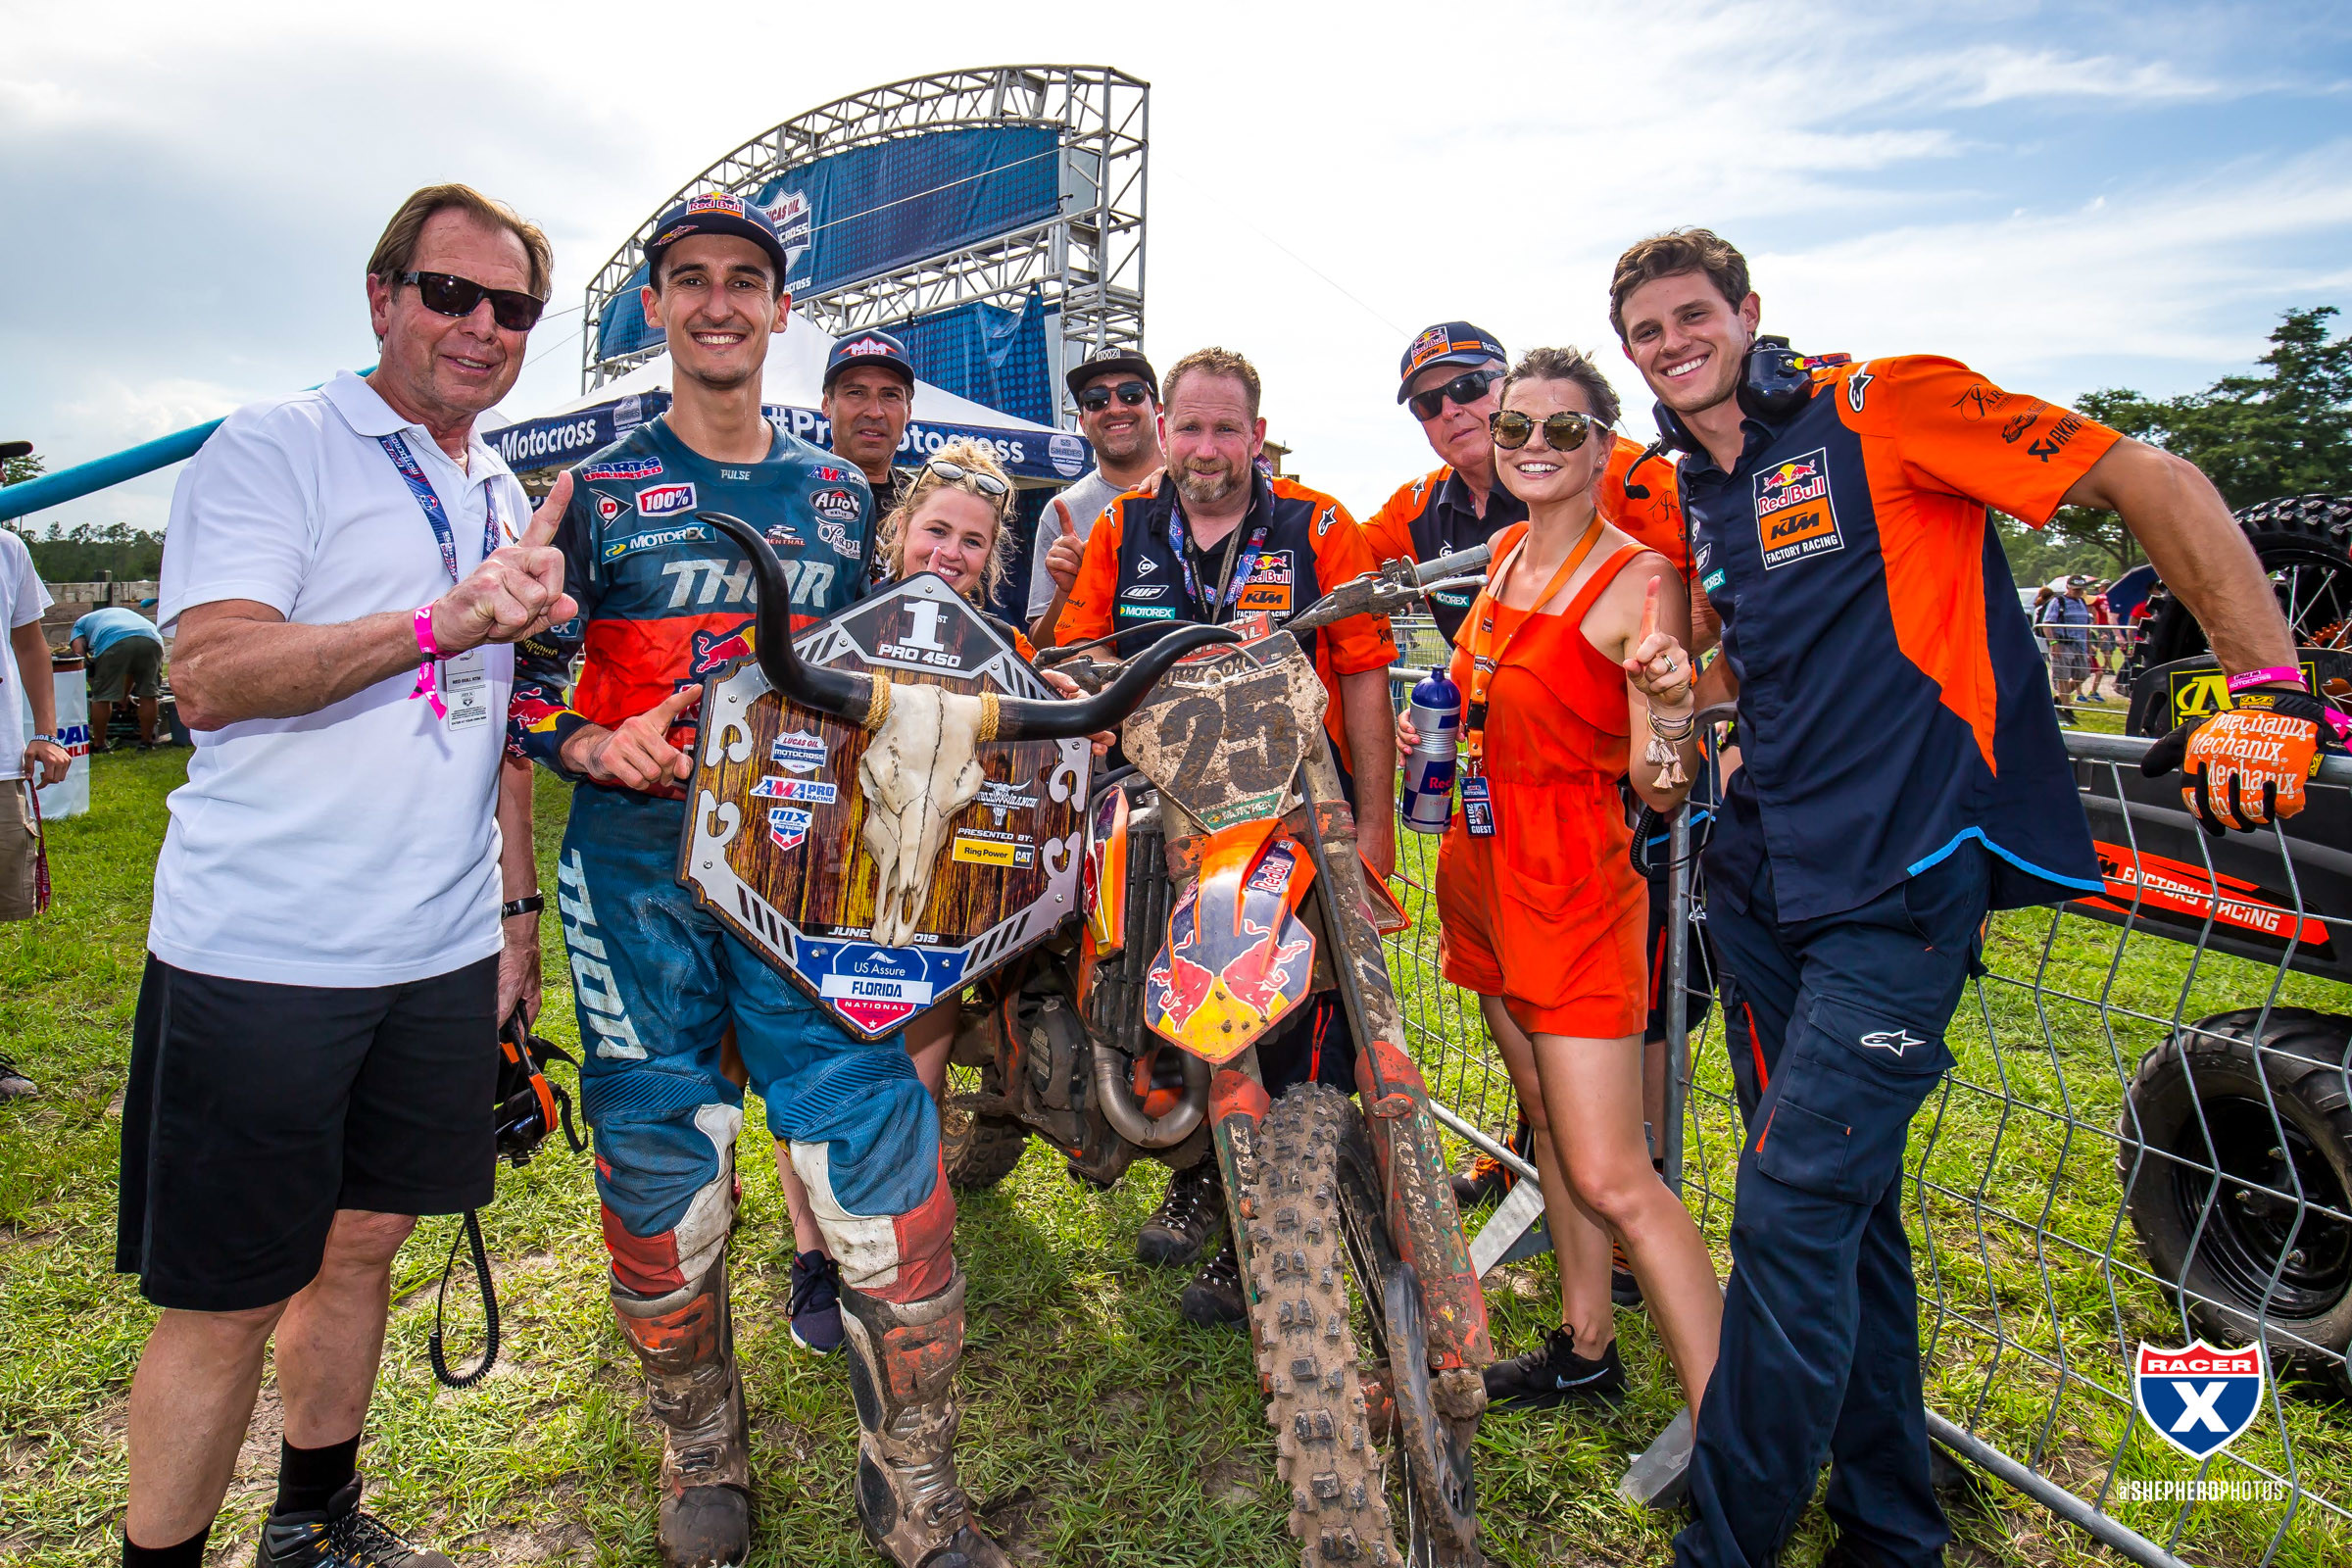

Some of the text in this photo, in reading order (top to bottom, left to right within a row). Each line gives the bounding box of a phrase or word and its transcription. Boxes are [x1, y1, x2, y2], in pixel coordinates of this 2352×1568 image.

[688, 200, 744, 213] Red Bull
[766, 199, 800, 223] UCAS OIL
[779, 222, 808, 242] CROSS
[1411, 334, 1446, 356] Red Bull
[1097, 348, 1120, 363] 100%
[1421, 348, 1440, 362] KTM
[390, 433, 419, 475] MOTOCROS
[580, 457, 662, 476] PARTS
[584, 466, 662, 481] UNLIMITED
[720, 468, 751, 481] PULSE
[808, 465, 849, 481] AMA
[645, 488, 689, 512] 100%
[1758, 476, 1826, 515] Red Bull
[603, 503, 616, 514] D
[1770, 511, 1820, 541] KTM
[629, 526, 707, 549] MOTOREX
[1765, 534, 1838, 564] FACTORY RACING
[662, 559, 834, 608] THR
[1246, 569, 1291, 583] ed Bull
[1244, 590, 1283, 604] KTM
[1125, 606, 1172, 617] MOTOREX
[1271, 610, 1291, 618] ACING
[878, 643, 961, 667] PRO 450
[783, 737, 806, 746] LUCAS
[1160, 673, 1298, 810] 25
[774, 750, 824, 760] MOTOCROSS
[757, 779, 835, 799] AMA PRO
[1429, 776, 1454, 789] Red
[1010, 795, 1039, 808] RANCH
[957, 827, 1033, 843] PRESENTED BY:
[1471, 825, 1492, 834] GUEST
[964, 847, 1032, 862] Ring Power CAT
[828, 926, 939, 944] JUNE 019
[558, 848, 649, 1059] THOR
[855, 961, 906, 977] US Assure
[852, 981, 903, 998] FLORIDA
[844, 1001, 906, 1011] NATIONAL
